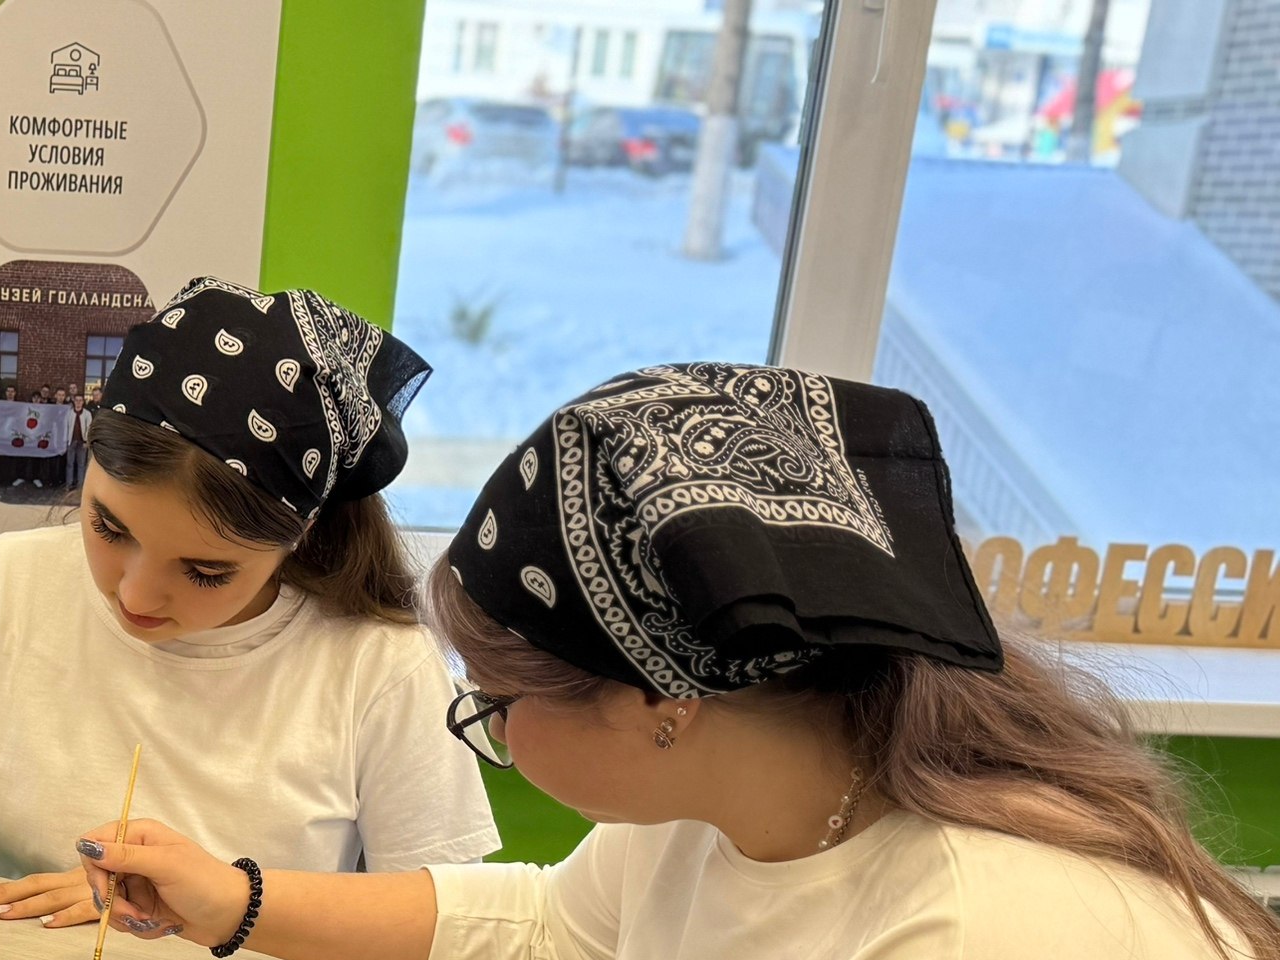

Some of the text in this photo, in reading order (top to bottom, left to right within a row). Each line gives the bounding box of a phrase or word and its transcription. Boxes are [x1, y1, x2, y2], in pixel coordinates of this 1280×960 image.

[9, 115, 128, 140] КОМФОРТНЫЕ
[28, 144, 105, 166] УСЛОВИЯ
[8, 170, 123, 195] ПРОЖИВАНИЯ
